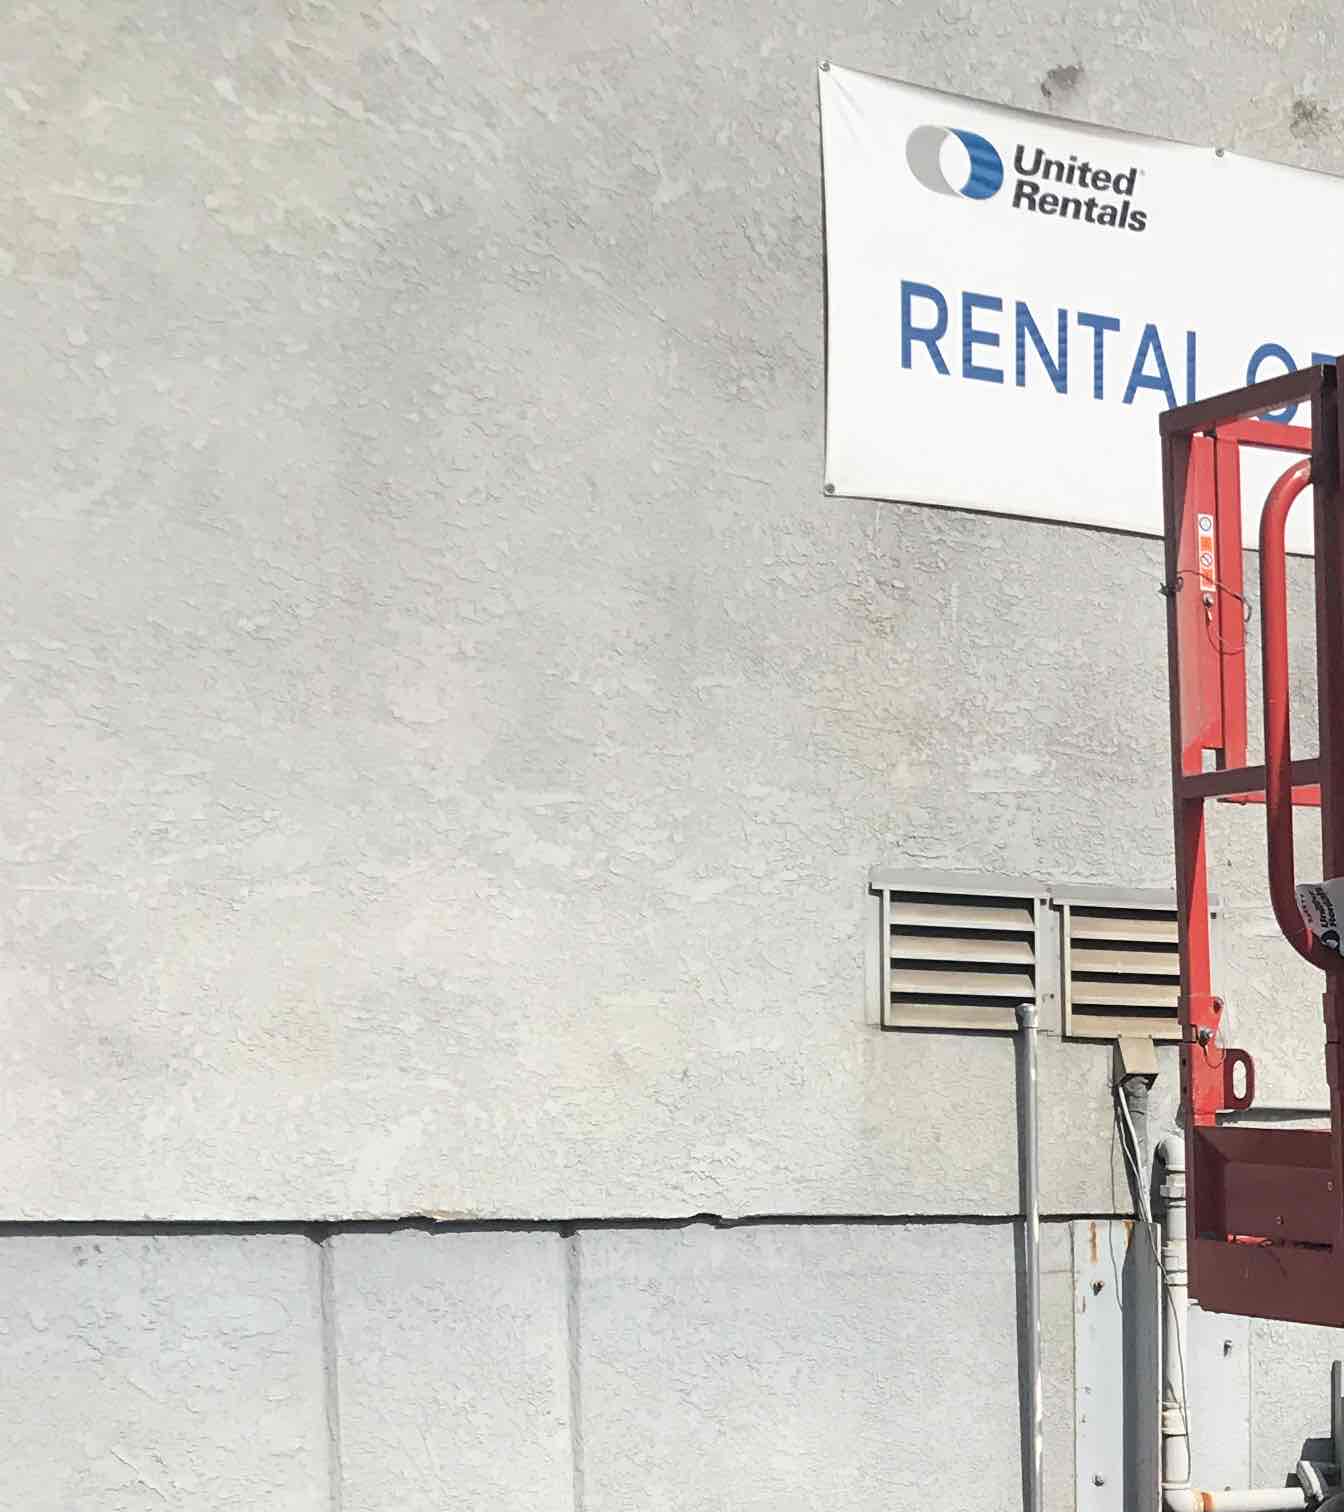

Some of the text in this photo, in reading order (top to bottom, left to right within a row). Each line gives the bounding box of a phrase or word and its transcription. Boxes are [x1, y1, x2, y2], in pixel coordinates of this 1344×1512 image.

[1013, 143, 1138, 197] United
[1012, 178, 1148, 232] Rentals
[900, 279, 1200, 410] RENTAL
